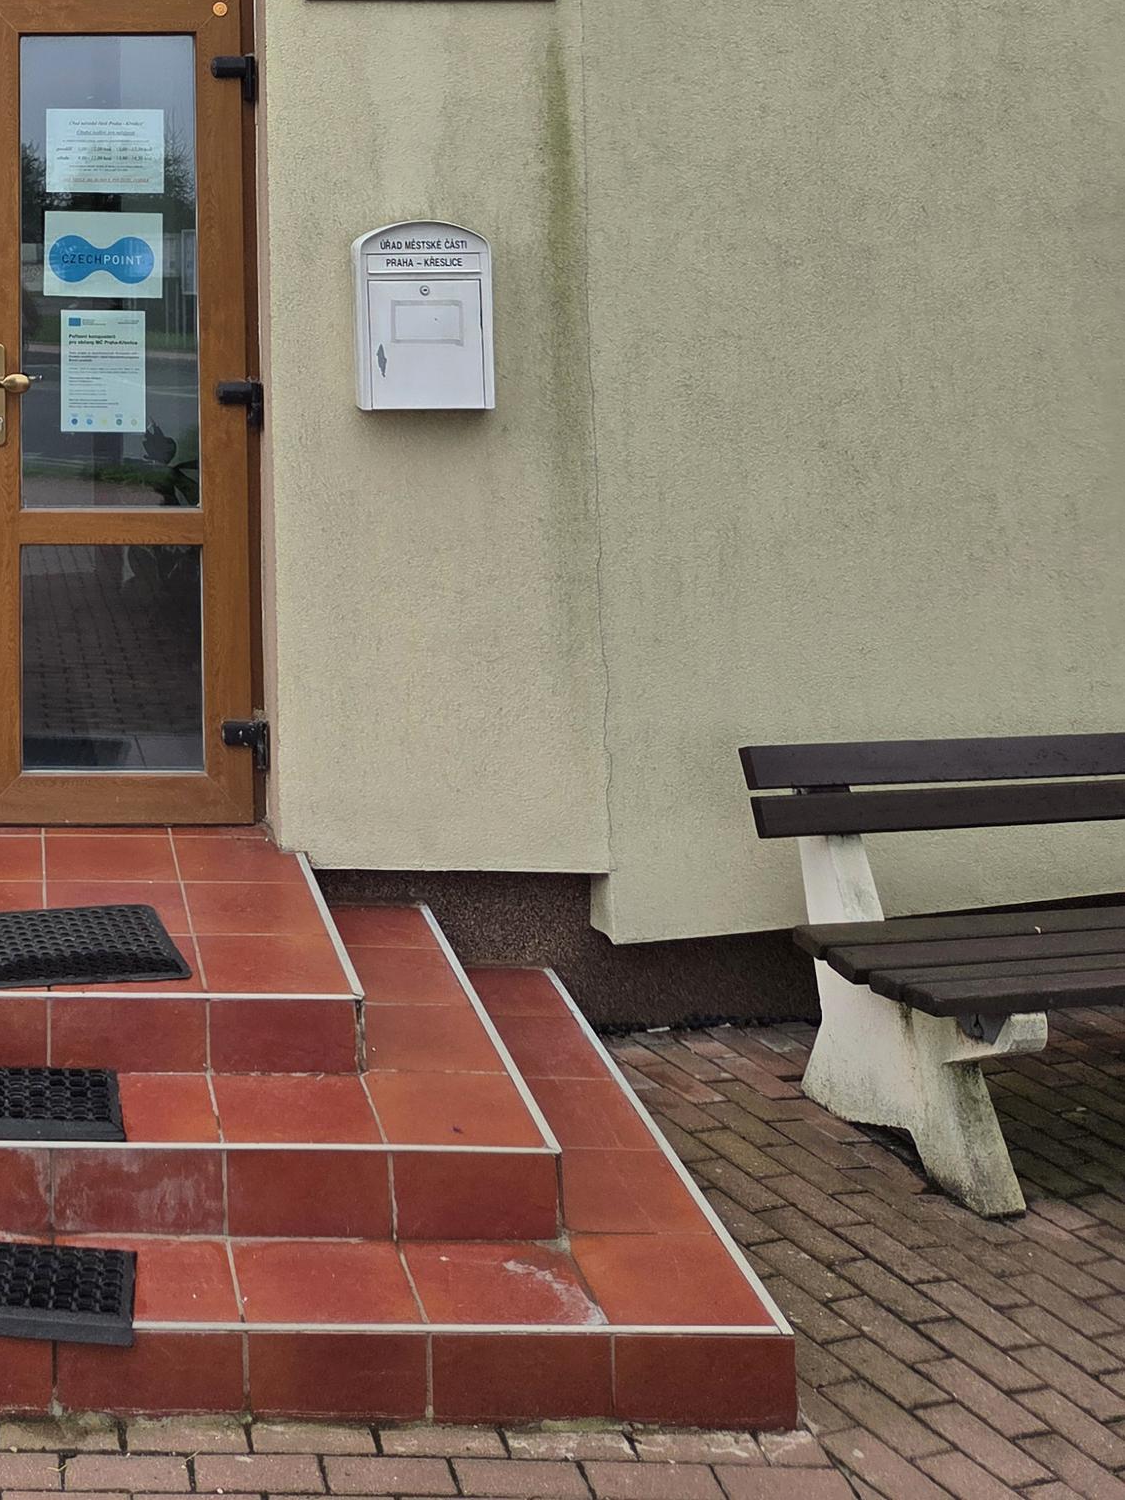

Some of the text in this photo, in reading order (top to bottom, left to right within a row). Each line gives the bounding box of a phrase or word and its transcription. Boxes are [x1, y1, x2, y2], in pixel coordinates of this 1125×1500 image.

[380, 239, 403, 250] ÚŘAD
[386, 258, 414, 268] PRAHA
[424, 256, 463, 268] KŘESLICE
